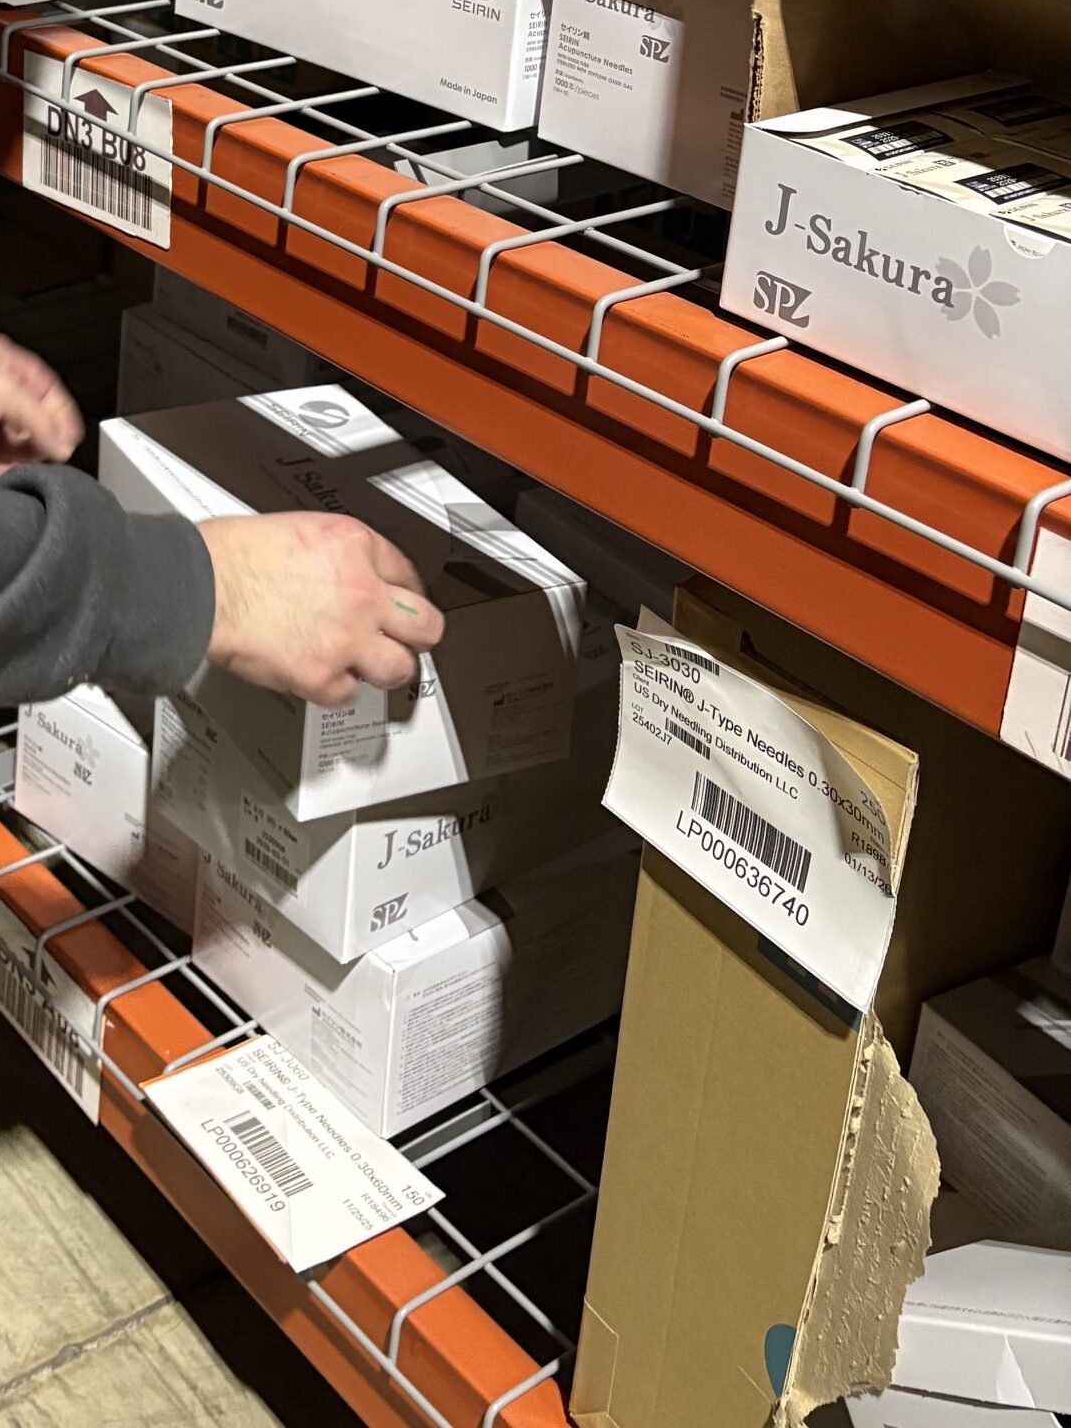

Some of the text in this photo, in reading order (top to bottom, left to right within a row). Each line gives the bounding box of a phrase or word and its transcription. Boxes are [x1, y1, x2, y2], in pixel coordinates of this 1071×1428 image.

[558, 42, 633, 74] Acupuncture Needles
[559, 33, 579, 46] SEIRIN
[439, 77, 464, 93] Made
[472, 87, 498, 104] Japan
[47, 106, 93, 150] DN3
[764, 182, 955, 308] J-Sakura
[631, 641, 701, 684] SJ-3030
[632, 712, 673, 746] 25402J7
[633, 682, 799, 800] US Dry Needling Distribution LLC
[633, 660, 885, 845] SEIRIN® J-Type Needles 0.30x30mm
[377, 804, 491, 870] J-Sakura
[851, 831, 890, 870] R1898
[675, 810, 810, 927] LP000636740
[844, 852, 892, 896] 01/13/26
[283, 1104, 320, 1144] Distribution
[315, 1141, 336, 1160] LLC
[287, 1083, 318, 1116] J-Type
[316, 1115, 352, 1154] Needles
[350, 1152, 404, 1212] 0.30x60mm
[200, 1117, 286, 1213] LP000626919
[400, 1183, 426, 1207] 150
